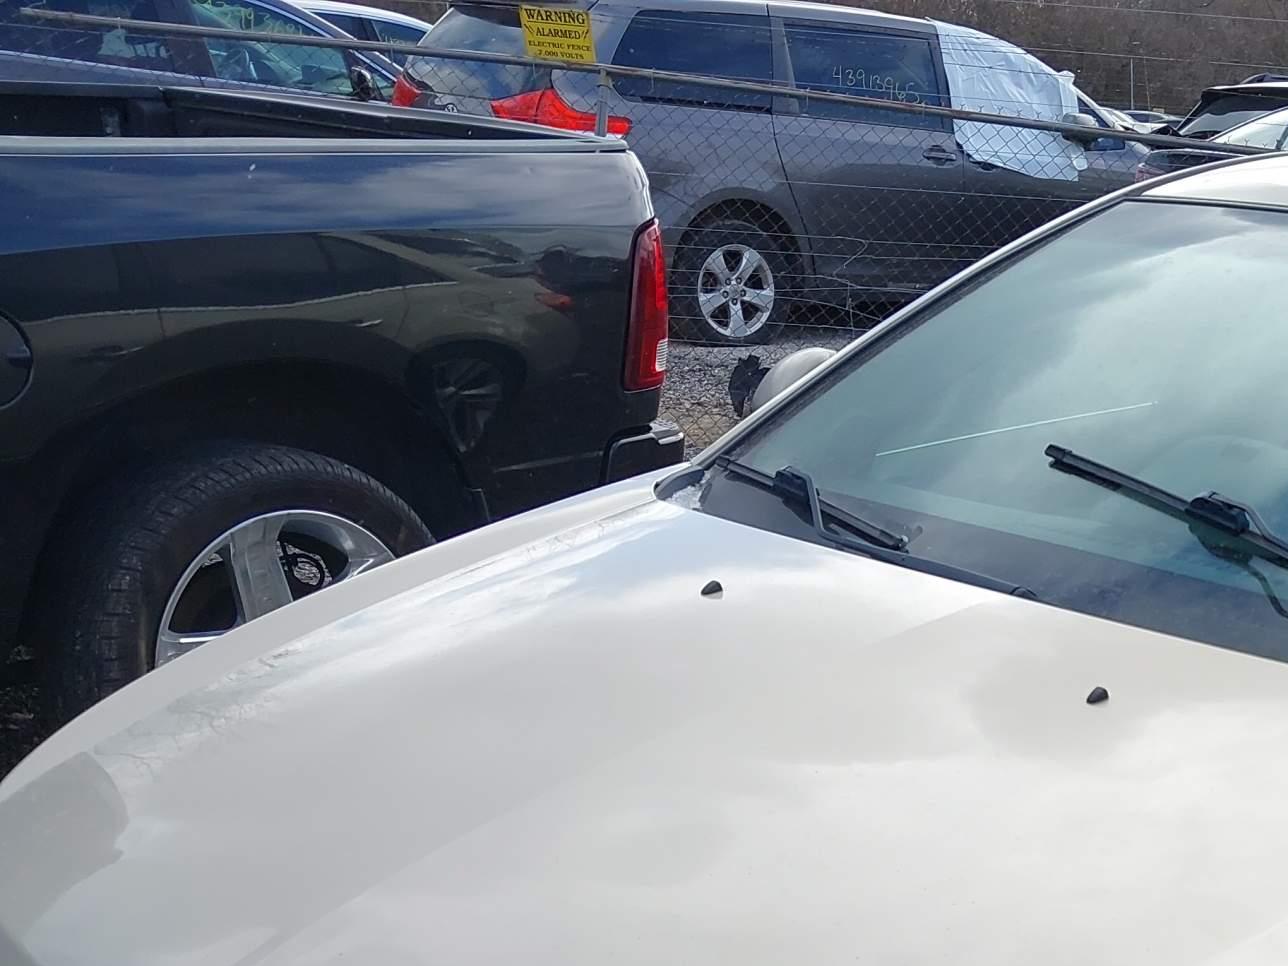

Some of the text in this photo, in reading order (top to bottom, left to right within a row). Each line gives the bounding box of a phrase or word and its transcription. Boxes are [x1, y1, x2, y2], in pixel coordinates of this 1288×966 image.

[523, 8, 585, 25] WARNING
[535, 27, 581, 40] ALARMED
[528, 40, 592, 52] ELECTRIC FENCE
[559, 52, 585, 60] VOLTS
